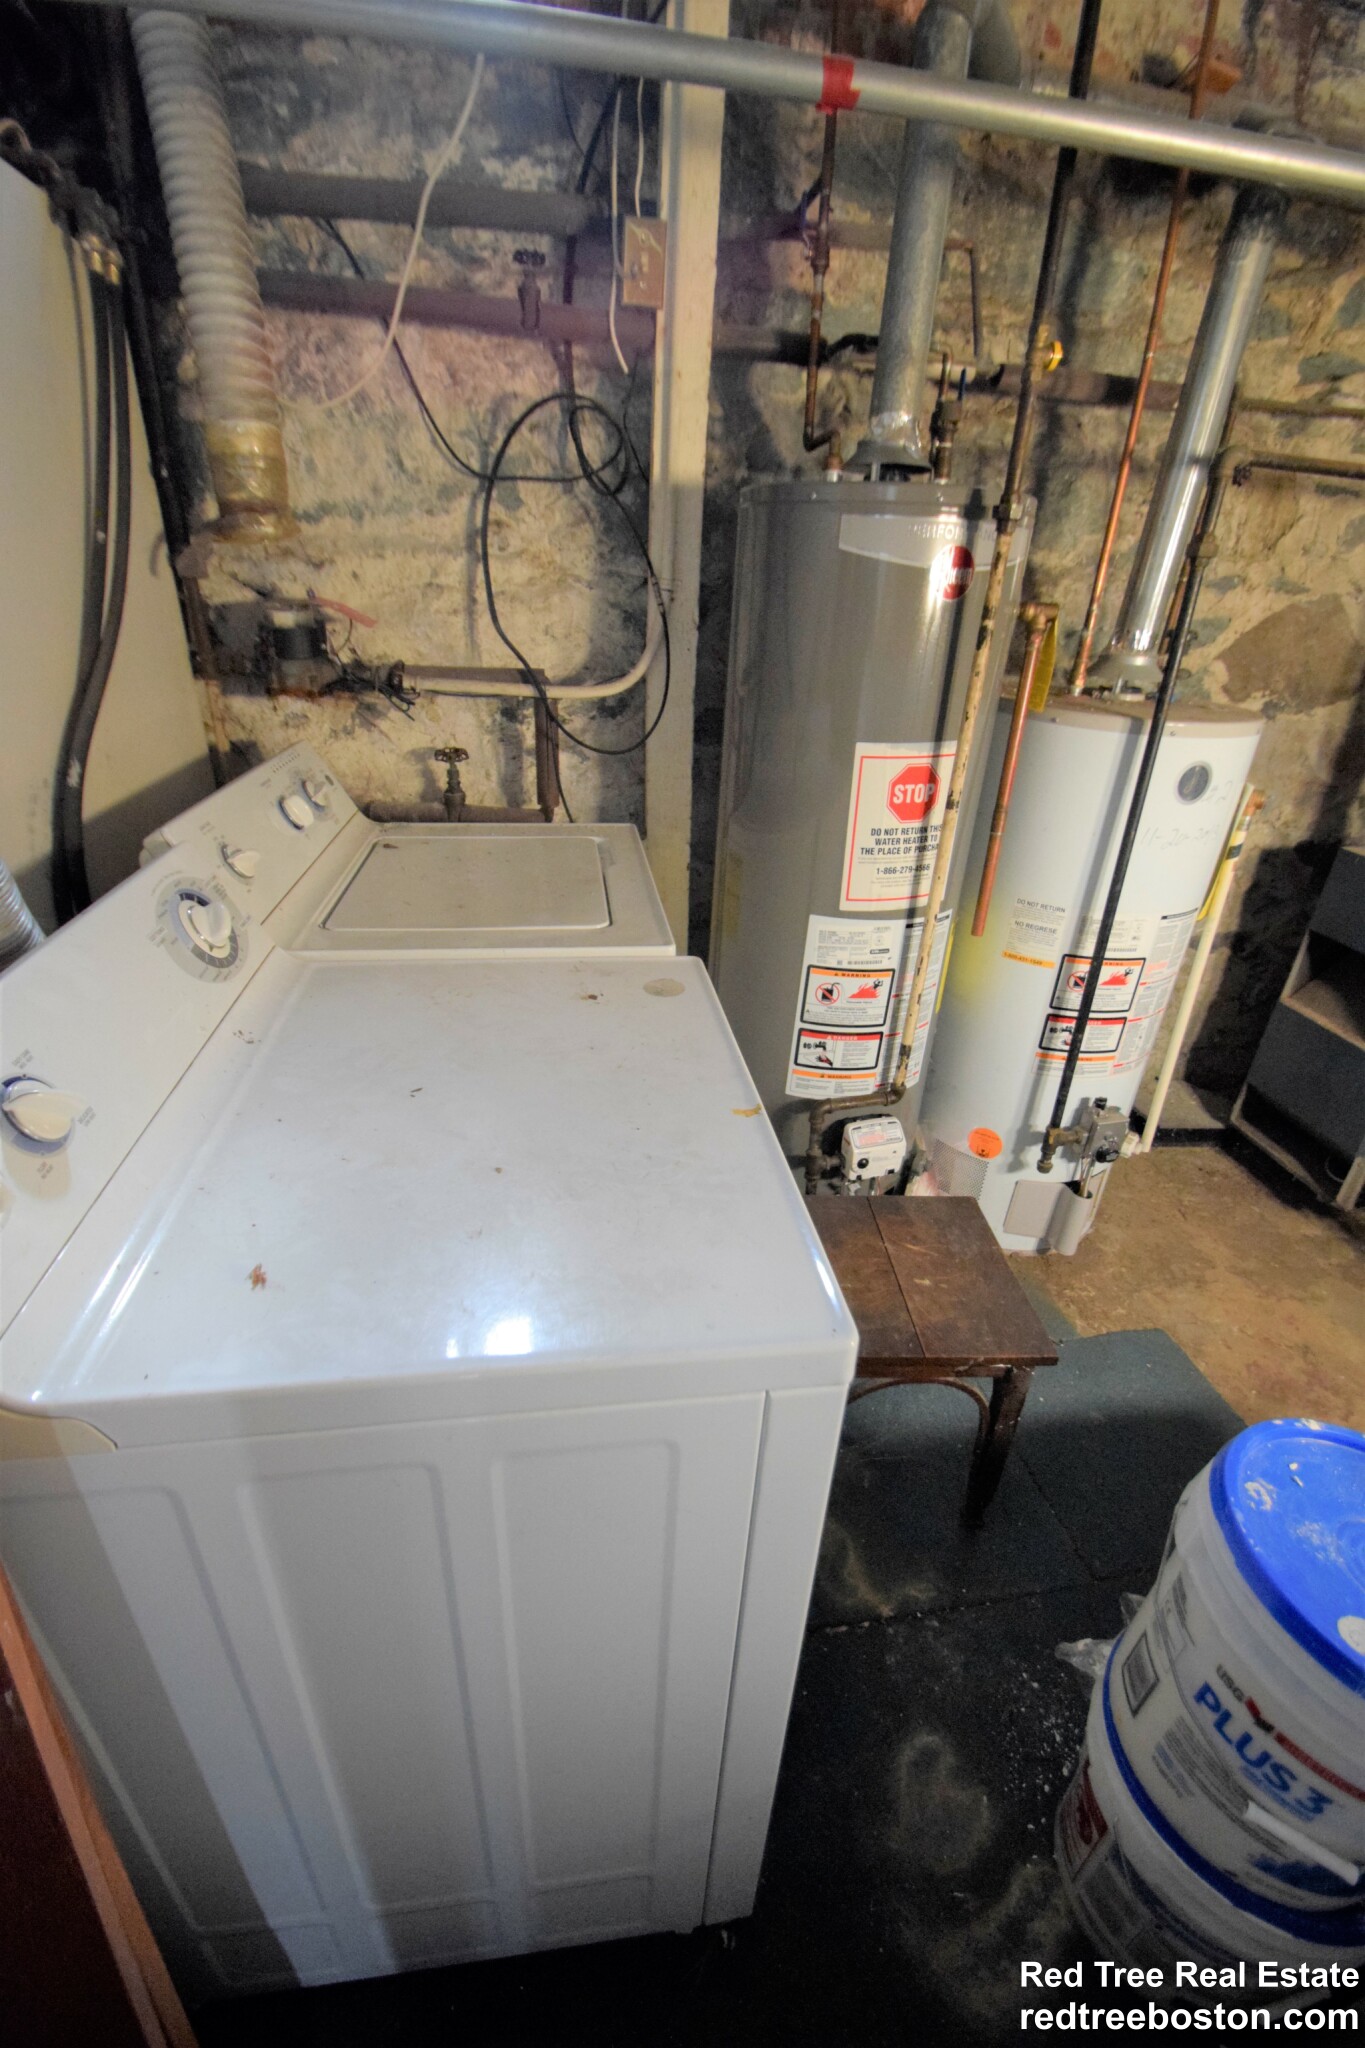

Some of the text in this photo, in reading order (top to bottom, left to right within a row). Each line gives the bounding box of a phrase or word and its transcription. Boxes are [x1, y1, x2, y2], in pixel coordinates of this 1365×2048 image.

[893, 783, 935, 804] STOP
[871, 828, 881, 837] DO
[884, 827, 898, 836] NOT
[901, 826, 928, 836] RETURN
[875, 834, 938, 846] WATER HEATER TO
[860, 847, 875, 856] THE
[877, 847, 901, 856] PLACE
[903, 846, 912, 855] OF
[1040, 903, 1066, 913] RETURN
[1193, 1680, 1298, 1796] PLUS
[1292, 1784, 1334, 1817] 3
